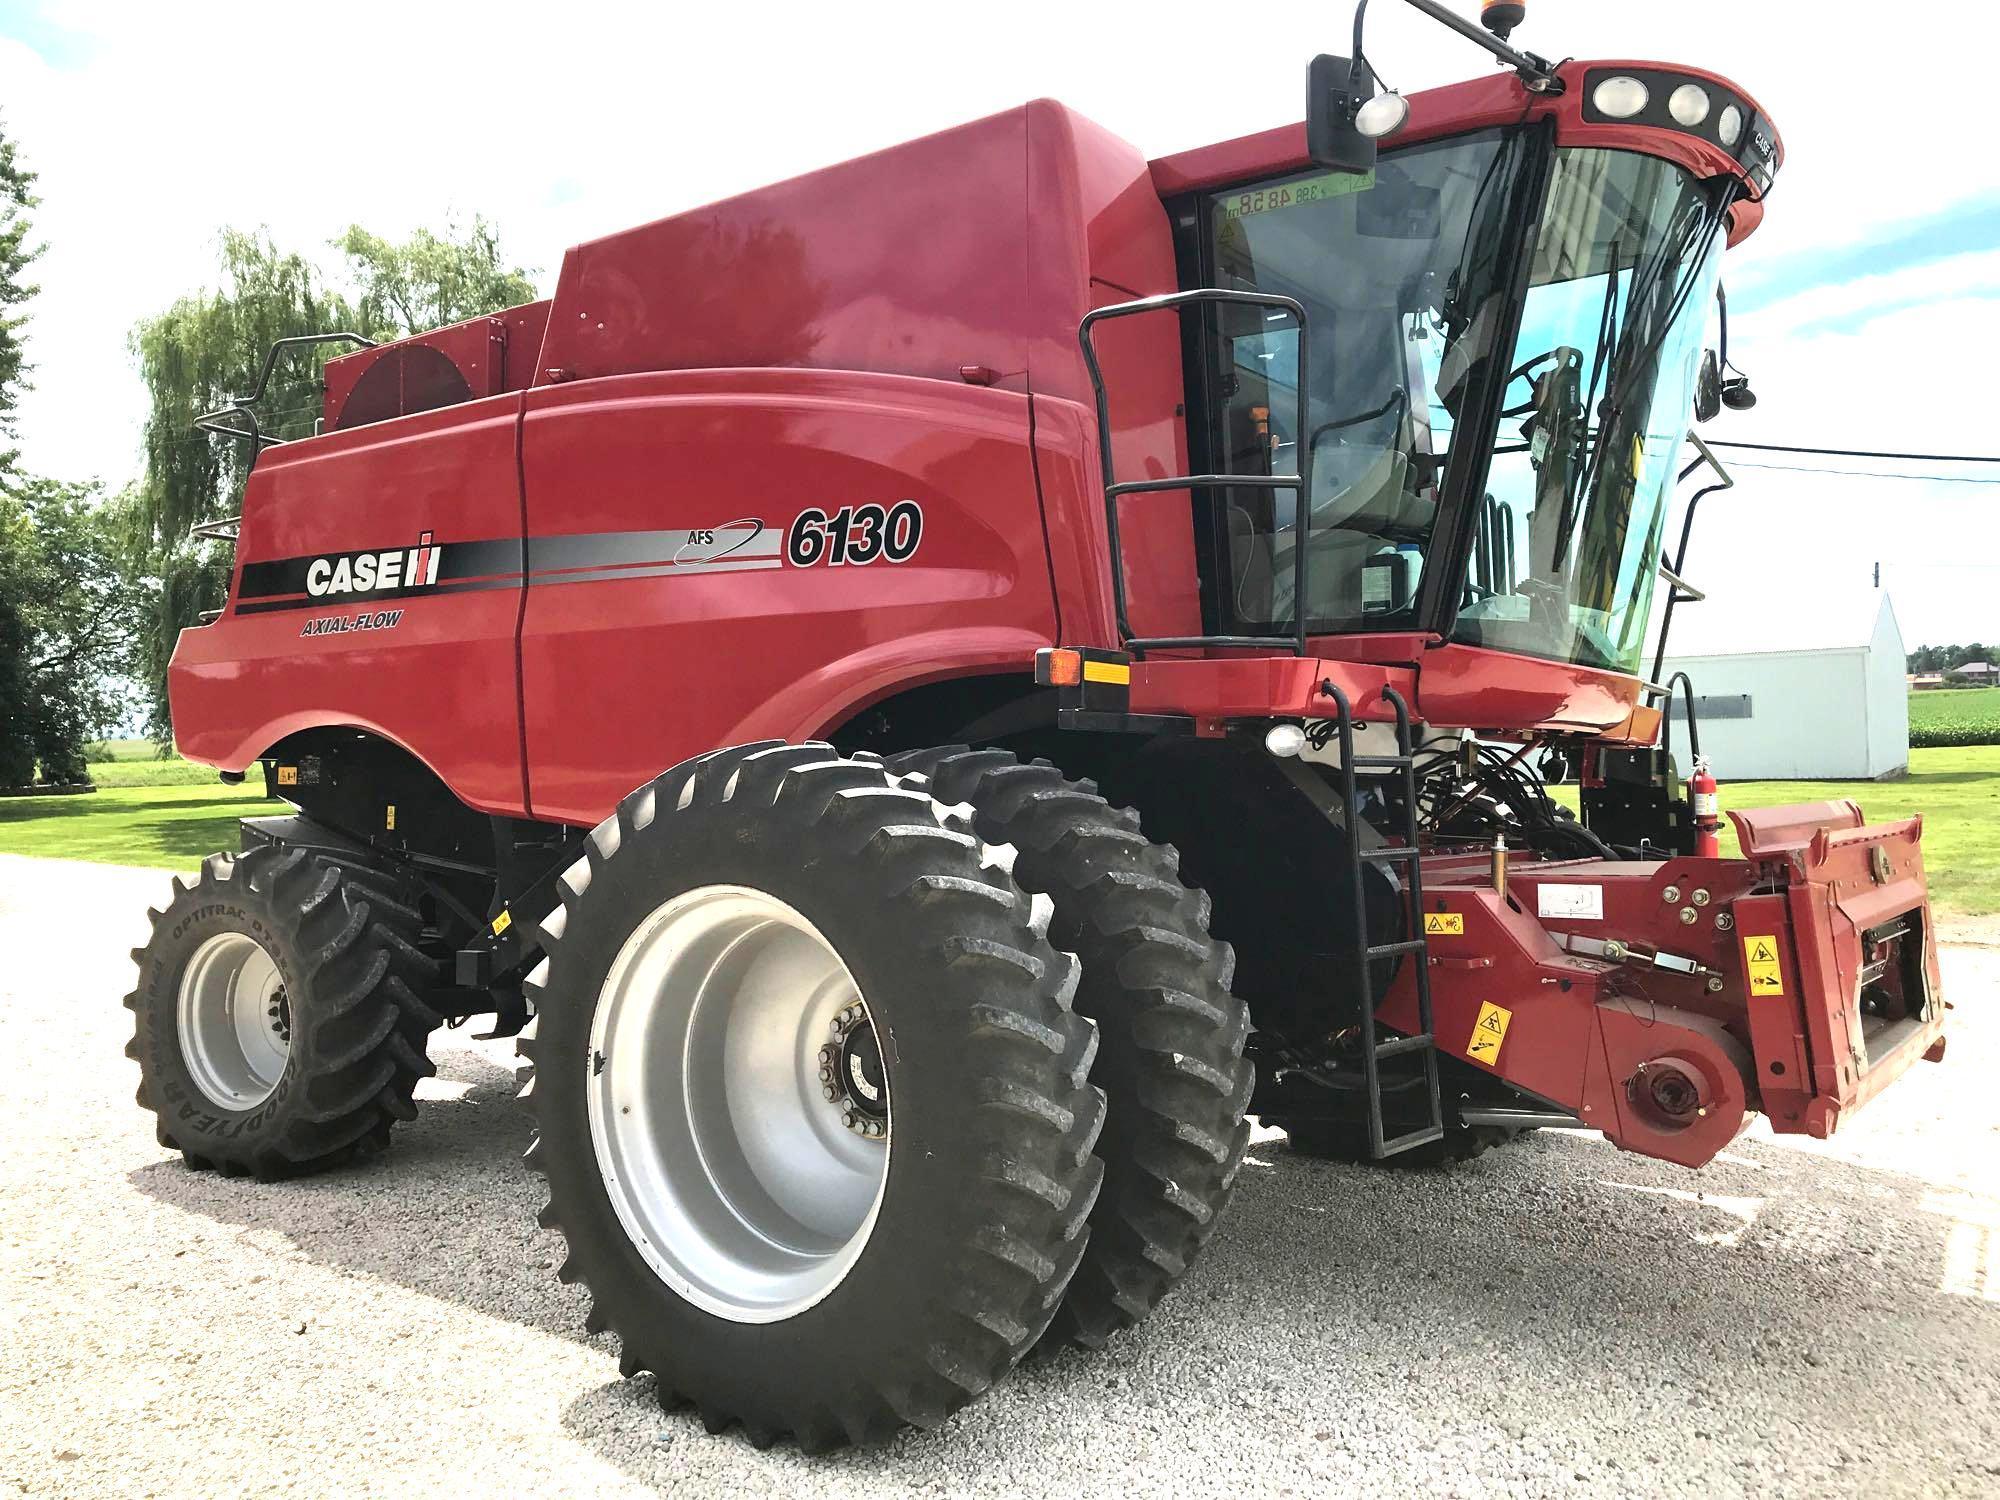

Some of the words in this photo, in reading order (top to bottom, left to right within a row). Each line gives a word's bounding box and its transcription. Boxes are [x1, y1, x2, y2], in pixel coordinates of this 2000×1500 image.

[1755, 132, 1770, 156] CASE
[687, 530, 714, 545] AFS
[788, 500, 923, 568] 6130
[306, 551, 403, 597] CASE
[300, 608, 404, 637] AXIAL-FLOW
[173, 903, 247, 940] OPTITRAC
[163, 1056, 296, 1138] GOODYEAR
